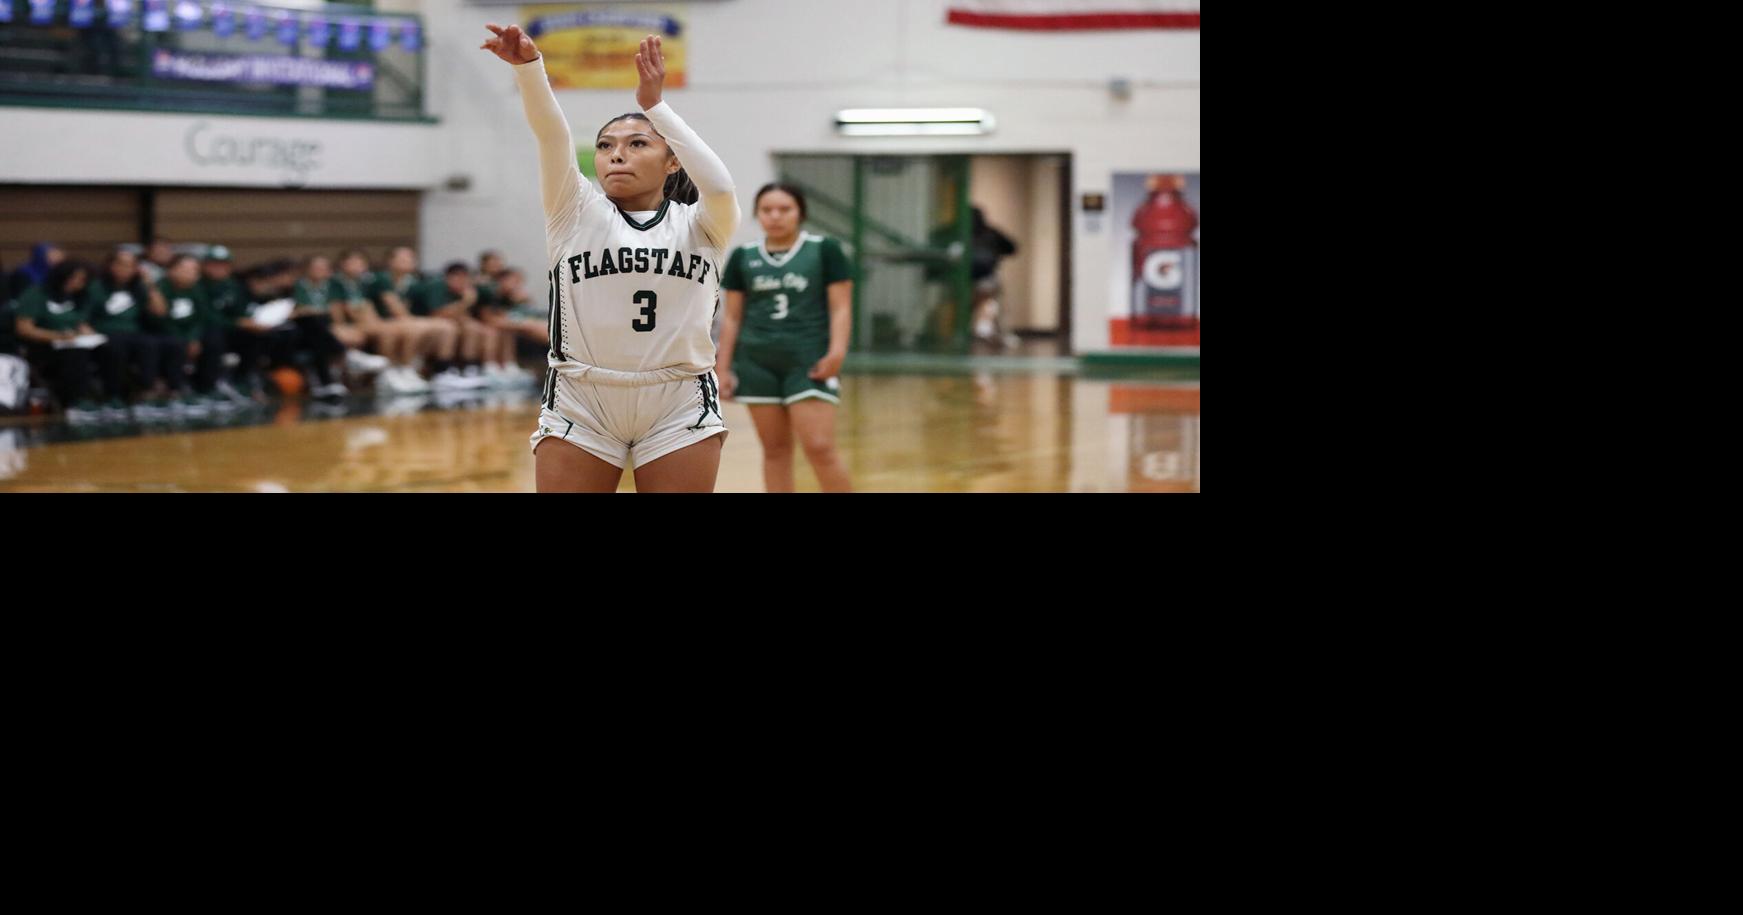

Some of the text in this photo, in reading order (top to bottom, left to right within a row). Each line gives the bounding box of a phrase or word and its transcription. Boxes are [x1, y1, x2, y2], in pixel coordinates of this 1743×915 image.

[568, 247, 710, 284] FLAGSTAFF
[1142, 250, 1182, 290] G
[632, 290, 657, 332] 3
[769, 293, 788, 319] 3
